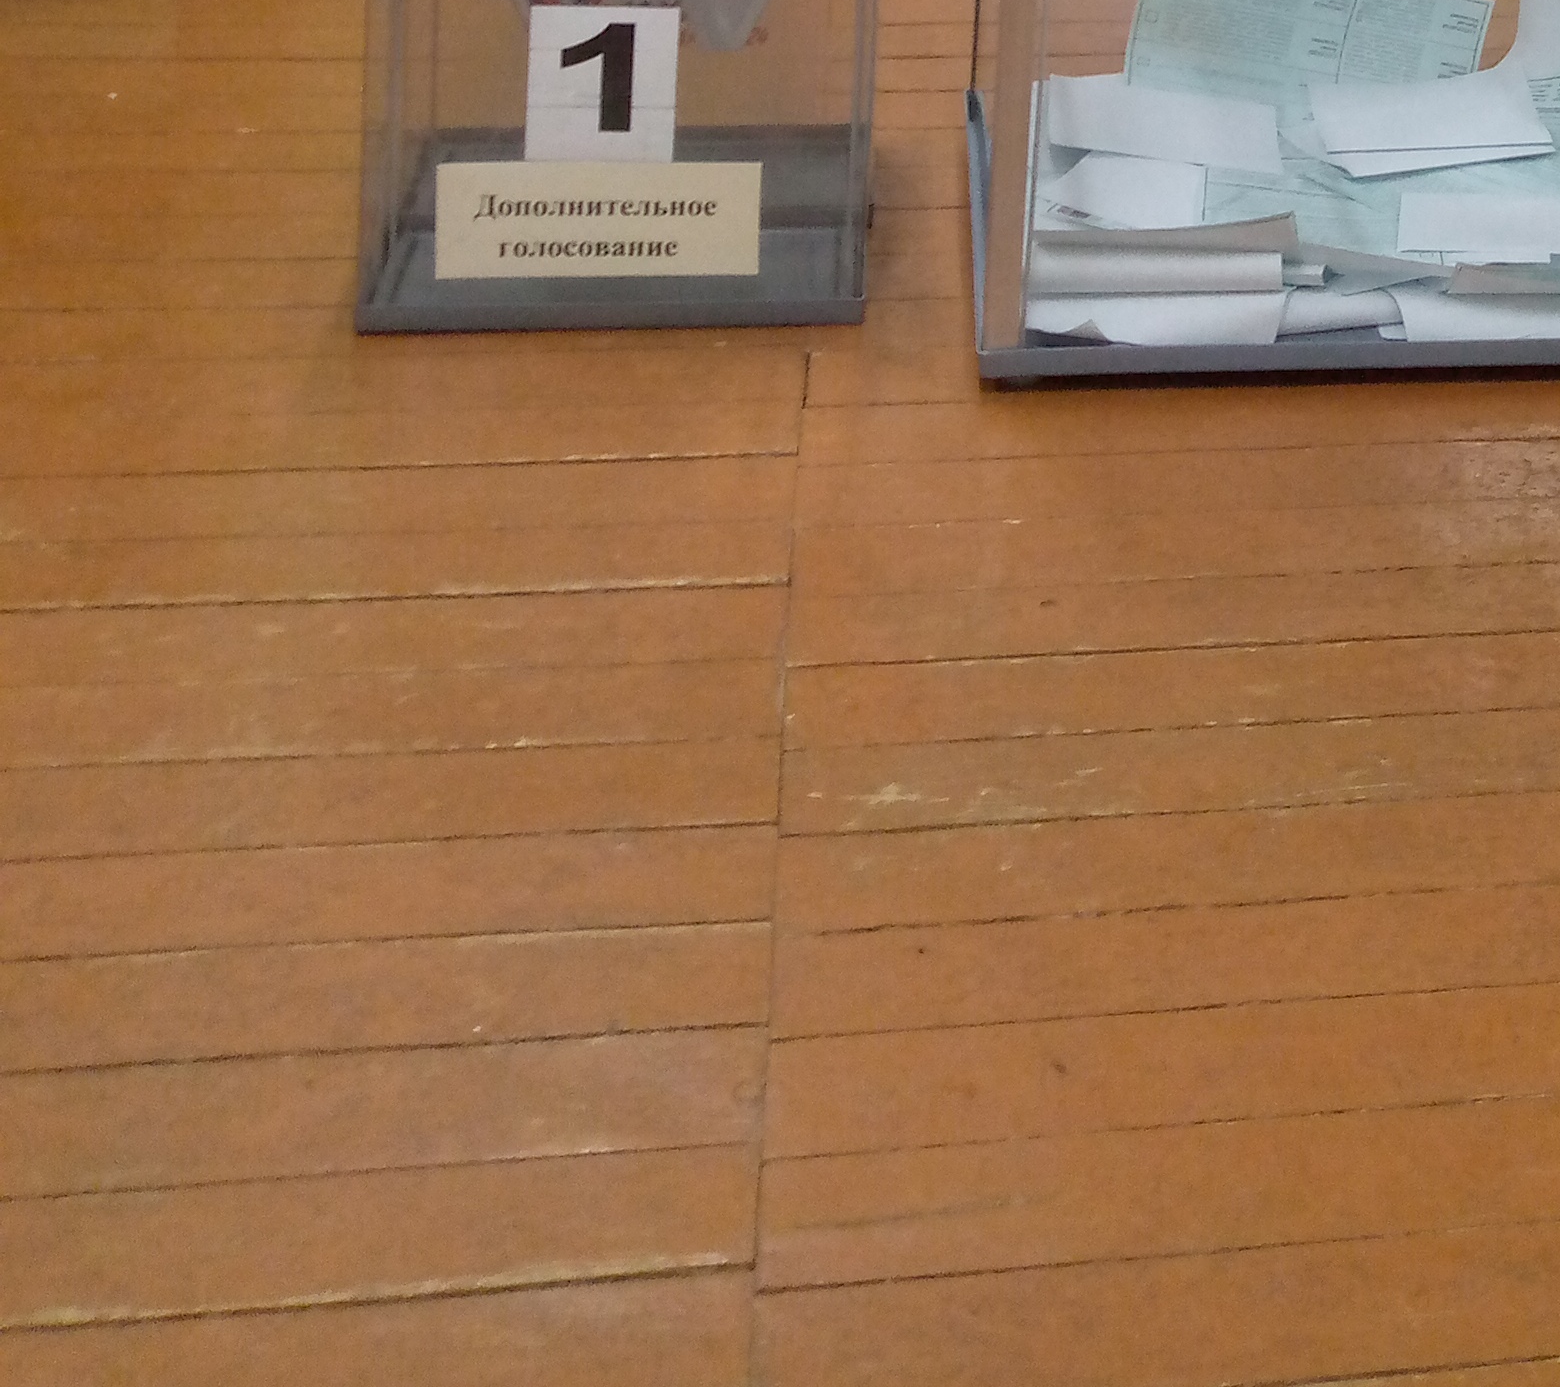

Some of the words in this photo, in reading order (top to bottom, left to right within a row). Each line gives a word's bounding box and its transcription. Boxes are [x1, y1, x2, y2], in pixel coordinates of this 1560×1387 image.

[560, 23, 636, 132] 1
[473, 194, 718, 222] Дополнительное
[498, 239, 679, 259] голосование
